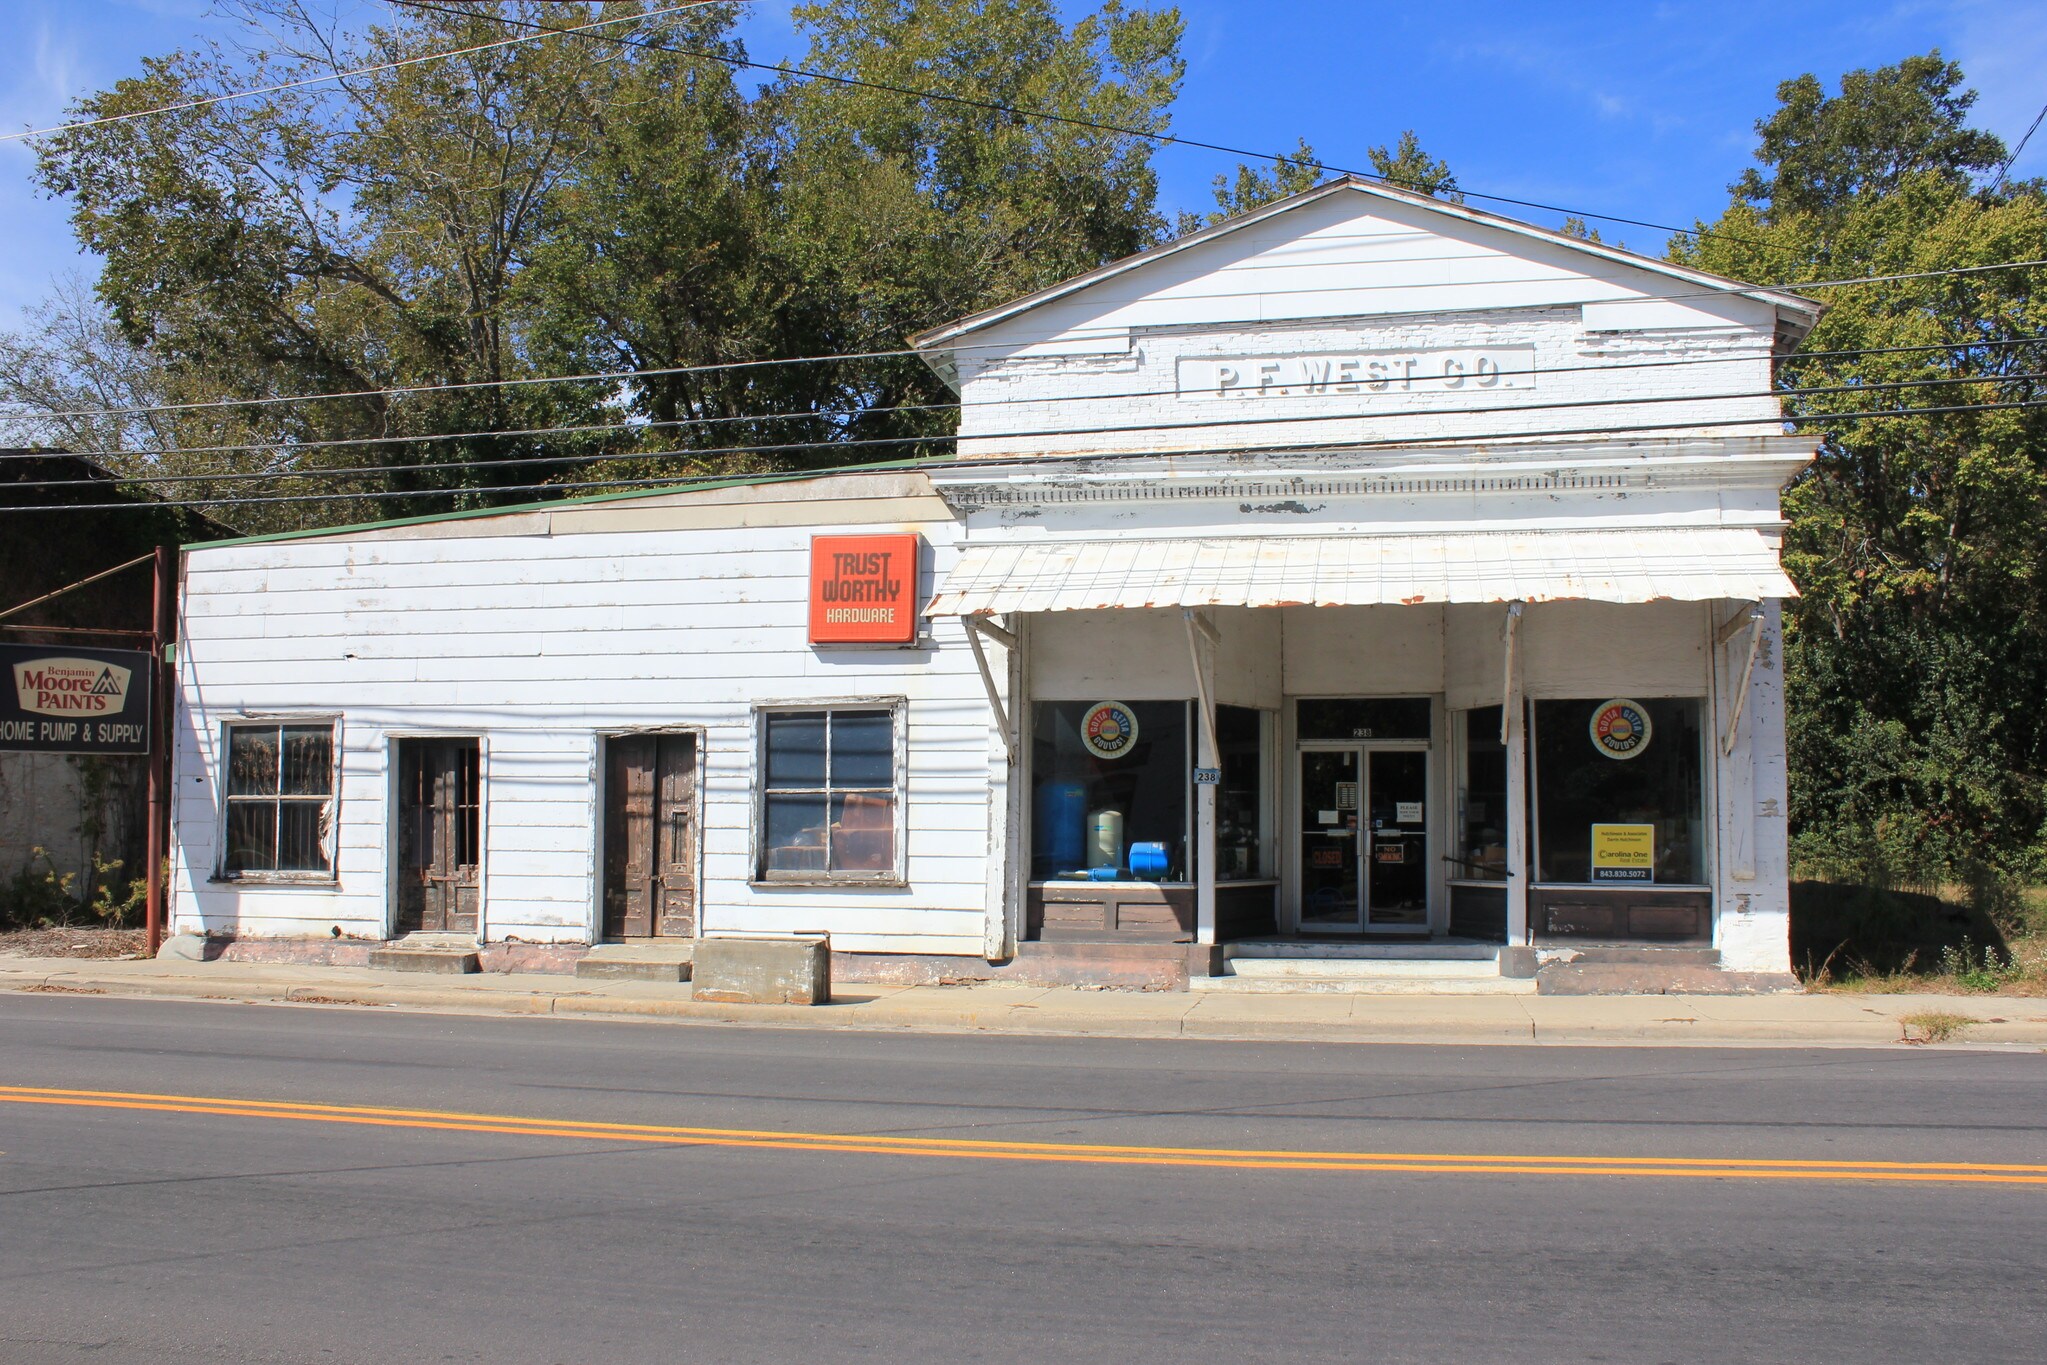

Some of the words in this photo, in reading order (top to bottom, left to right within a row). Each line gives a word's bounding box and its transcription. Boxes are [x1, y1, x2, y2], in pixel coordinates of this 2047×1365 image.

[1298, 355, 1417, 394] WEST
[1442, 352, 1513, 389] CO.
[832, 552, 892, 576] TRUST
[822, 579, 900, 602] WORTHY
[826, 608, 895, 623] HARDWARE
[48, 666, 95, 677] Benjamin
[22, 670, 93, 692] Moore
[36, 691, 106, 711] PAINTS
[1090, 711, 1108, 732] GOTTA
[1112, 711, 1130, 732] GETTA
[1599, 709, 1618, 732] GOTTA
[1623, 709, 1642, 732] GETTA
[41, 722, 77, 741] PUMP
[82, 723, 92, 742] &
[98, 723, 143, 743] SUPPLY
[1353, 728, 1371, 737] 238
[1093, 736, 1126, 750] GOULDS!
[1603, 735, 1639, 750] GOULDS!
[1197, 772, 1216, 782] 238
[1599, 850, 1631, 859] Carolina
[1600, 870, 1646, 878] 843.830.5072
